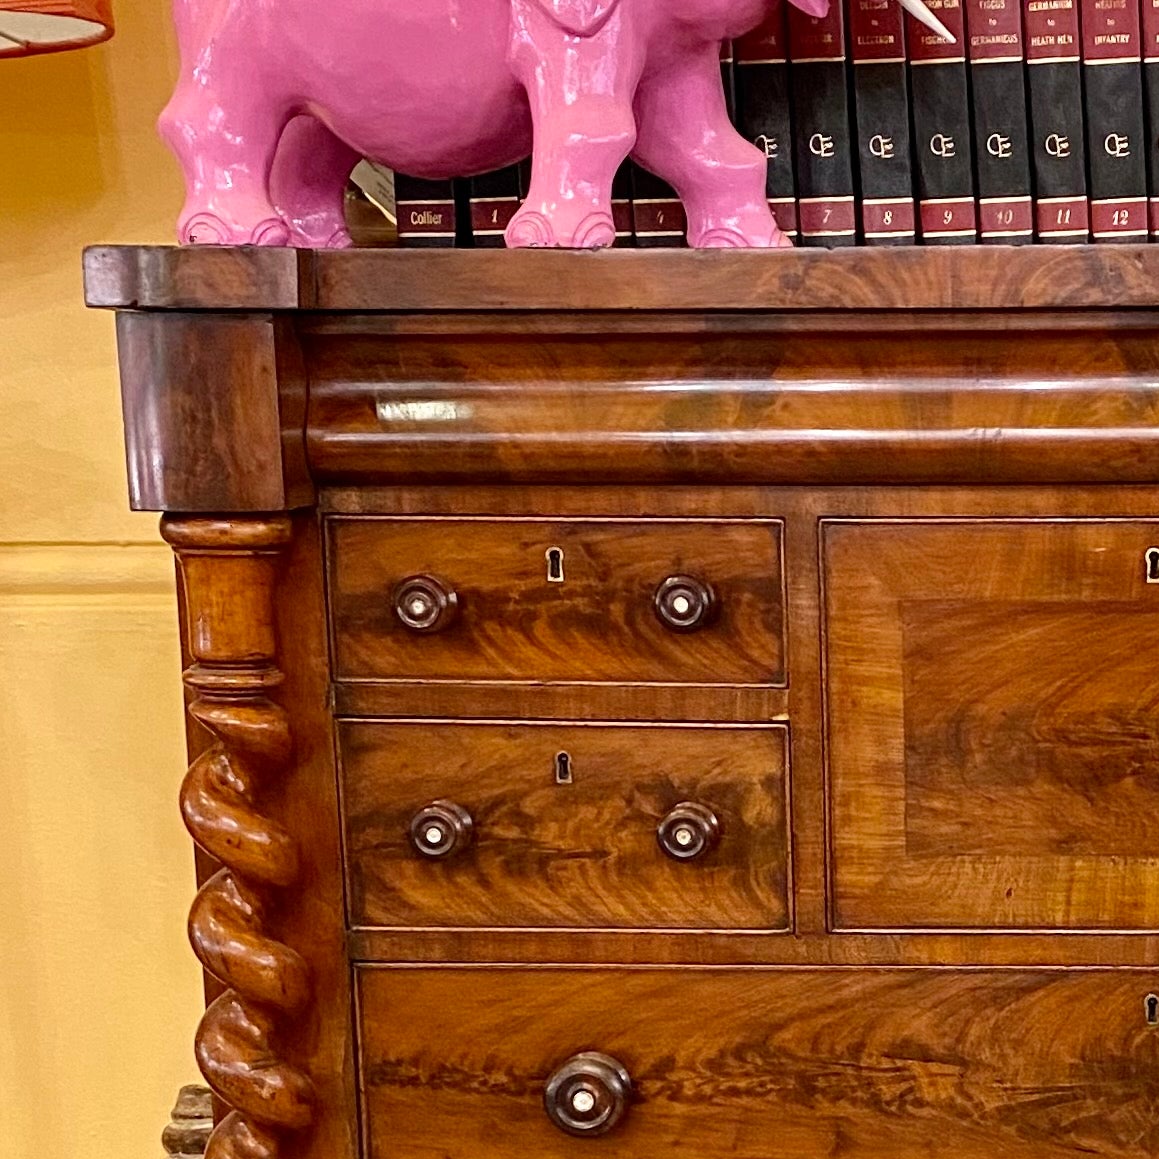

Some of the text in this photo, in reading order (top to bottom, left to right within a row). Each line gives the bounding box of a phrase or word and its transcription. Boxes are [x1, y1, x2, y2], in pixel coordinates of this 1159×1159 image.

[1047, 18, 1056, 26] to
[1106, 18, 1115, 26] to
[1031, 36, 1055, 46] HEATH
[1094, 34, 1130, 45] INFANTRY
[410, 211, 443, 226] Collier
[822, 209, 832, 223] 7
[884, 210, 893, 225] 8
[944, 210, 953, 225] 9
[996, 209, 1013, 224] 10
[1056, 209, 1071, 224] 11
[1112, 210, 1129, 225] 12
